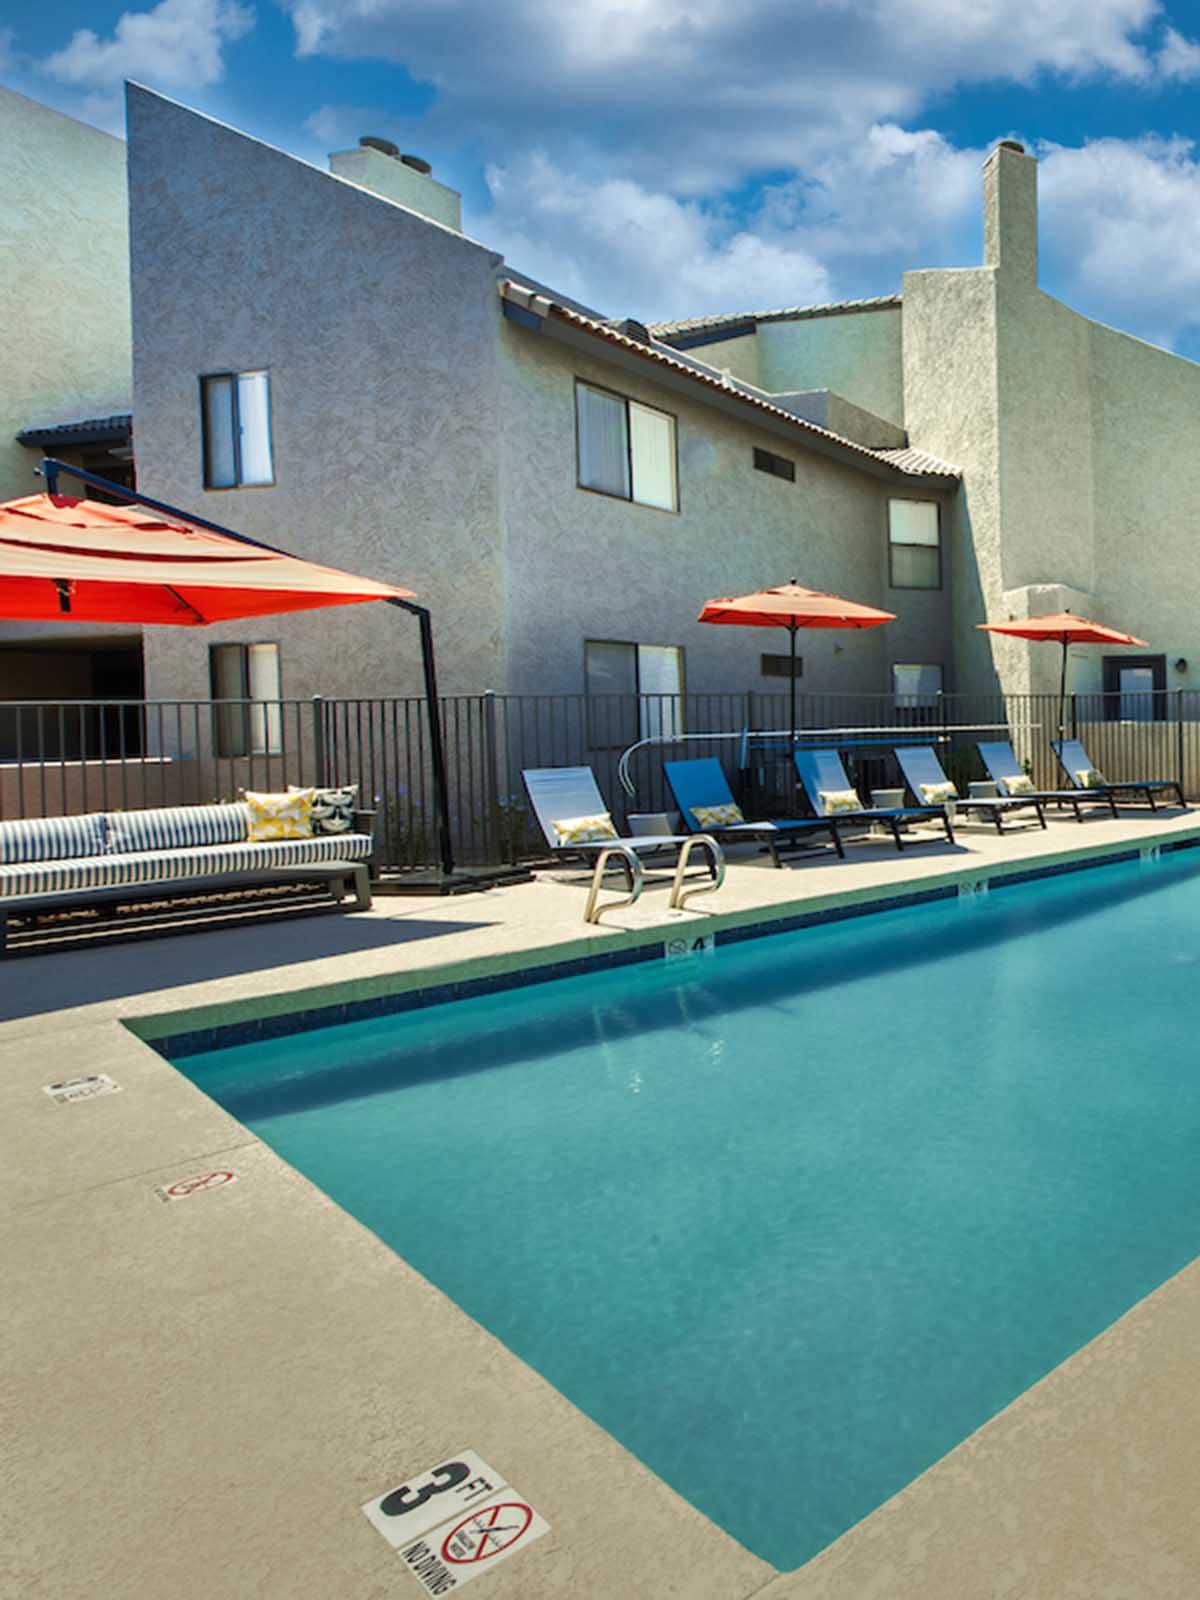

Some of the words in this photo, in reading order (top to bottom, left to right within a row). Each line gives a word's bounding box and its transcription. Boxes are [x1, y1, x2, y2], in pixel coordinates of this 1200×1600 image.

[380, 1461, 471, 1517] 3
[455, 1477, 493, 1501] FT
[401, 1540, 431, 1564] NO
[412, 1555, 457, 1596] DIVING
